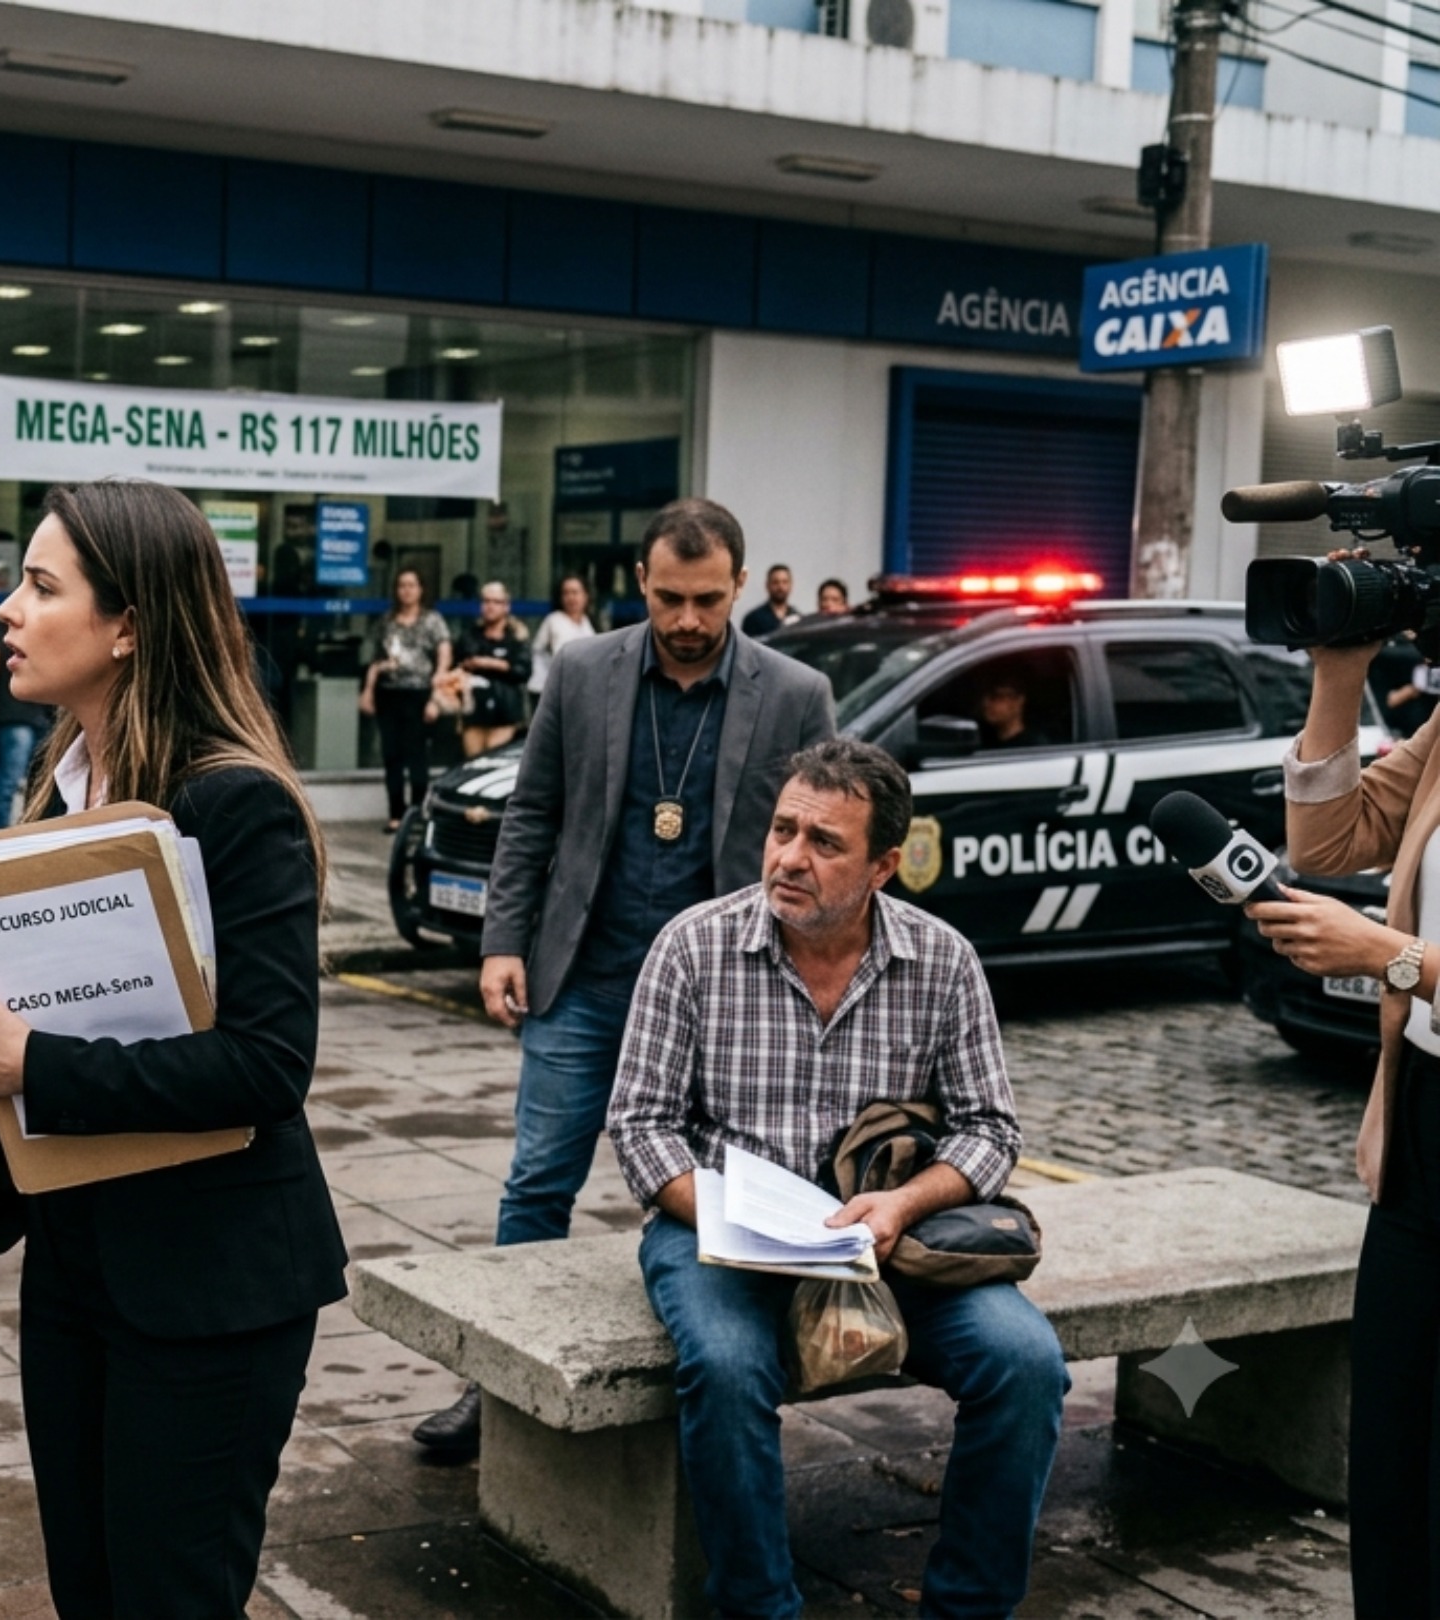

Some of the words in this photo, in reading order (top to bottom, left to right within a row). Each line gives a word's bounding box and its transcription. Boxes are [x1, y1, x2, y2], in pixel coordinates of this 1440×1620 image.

[936, 286, 1071, 338] AGÊNCIA
[1099, 265, 1230, 311] AGÊNCIA
[1093, 305, 1231, 357] CAIXA
[15, 398, 207, 450] MEGA-SENA
[239, 411, 279, 457] R$
[290, 415, 343, 455] 117
[952, 822, 1119, 879] POLÍCIA
[59, 892, 135, 922] JUDICIAL
[6, 992, 52, 1013] CASO
[54, 974, 155, 1006] MEGA-Sena
